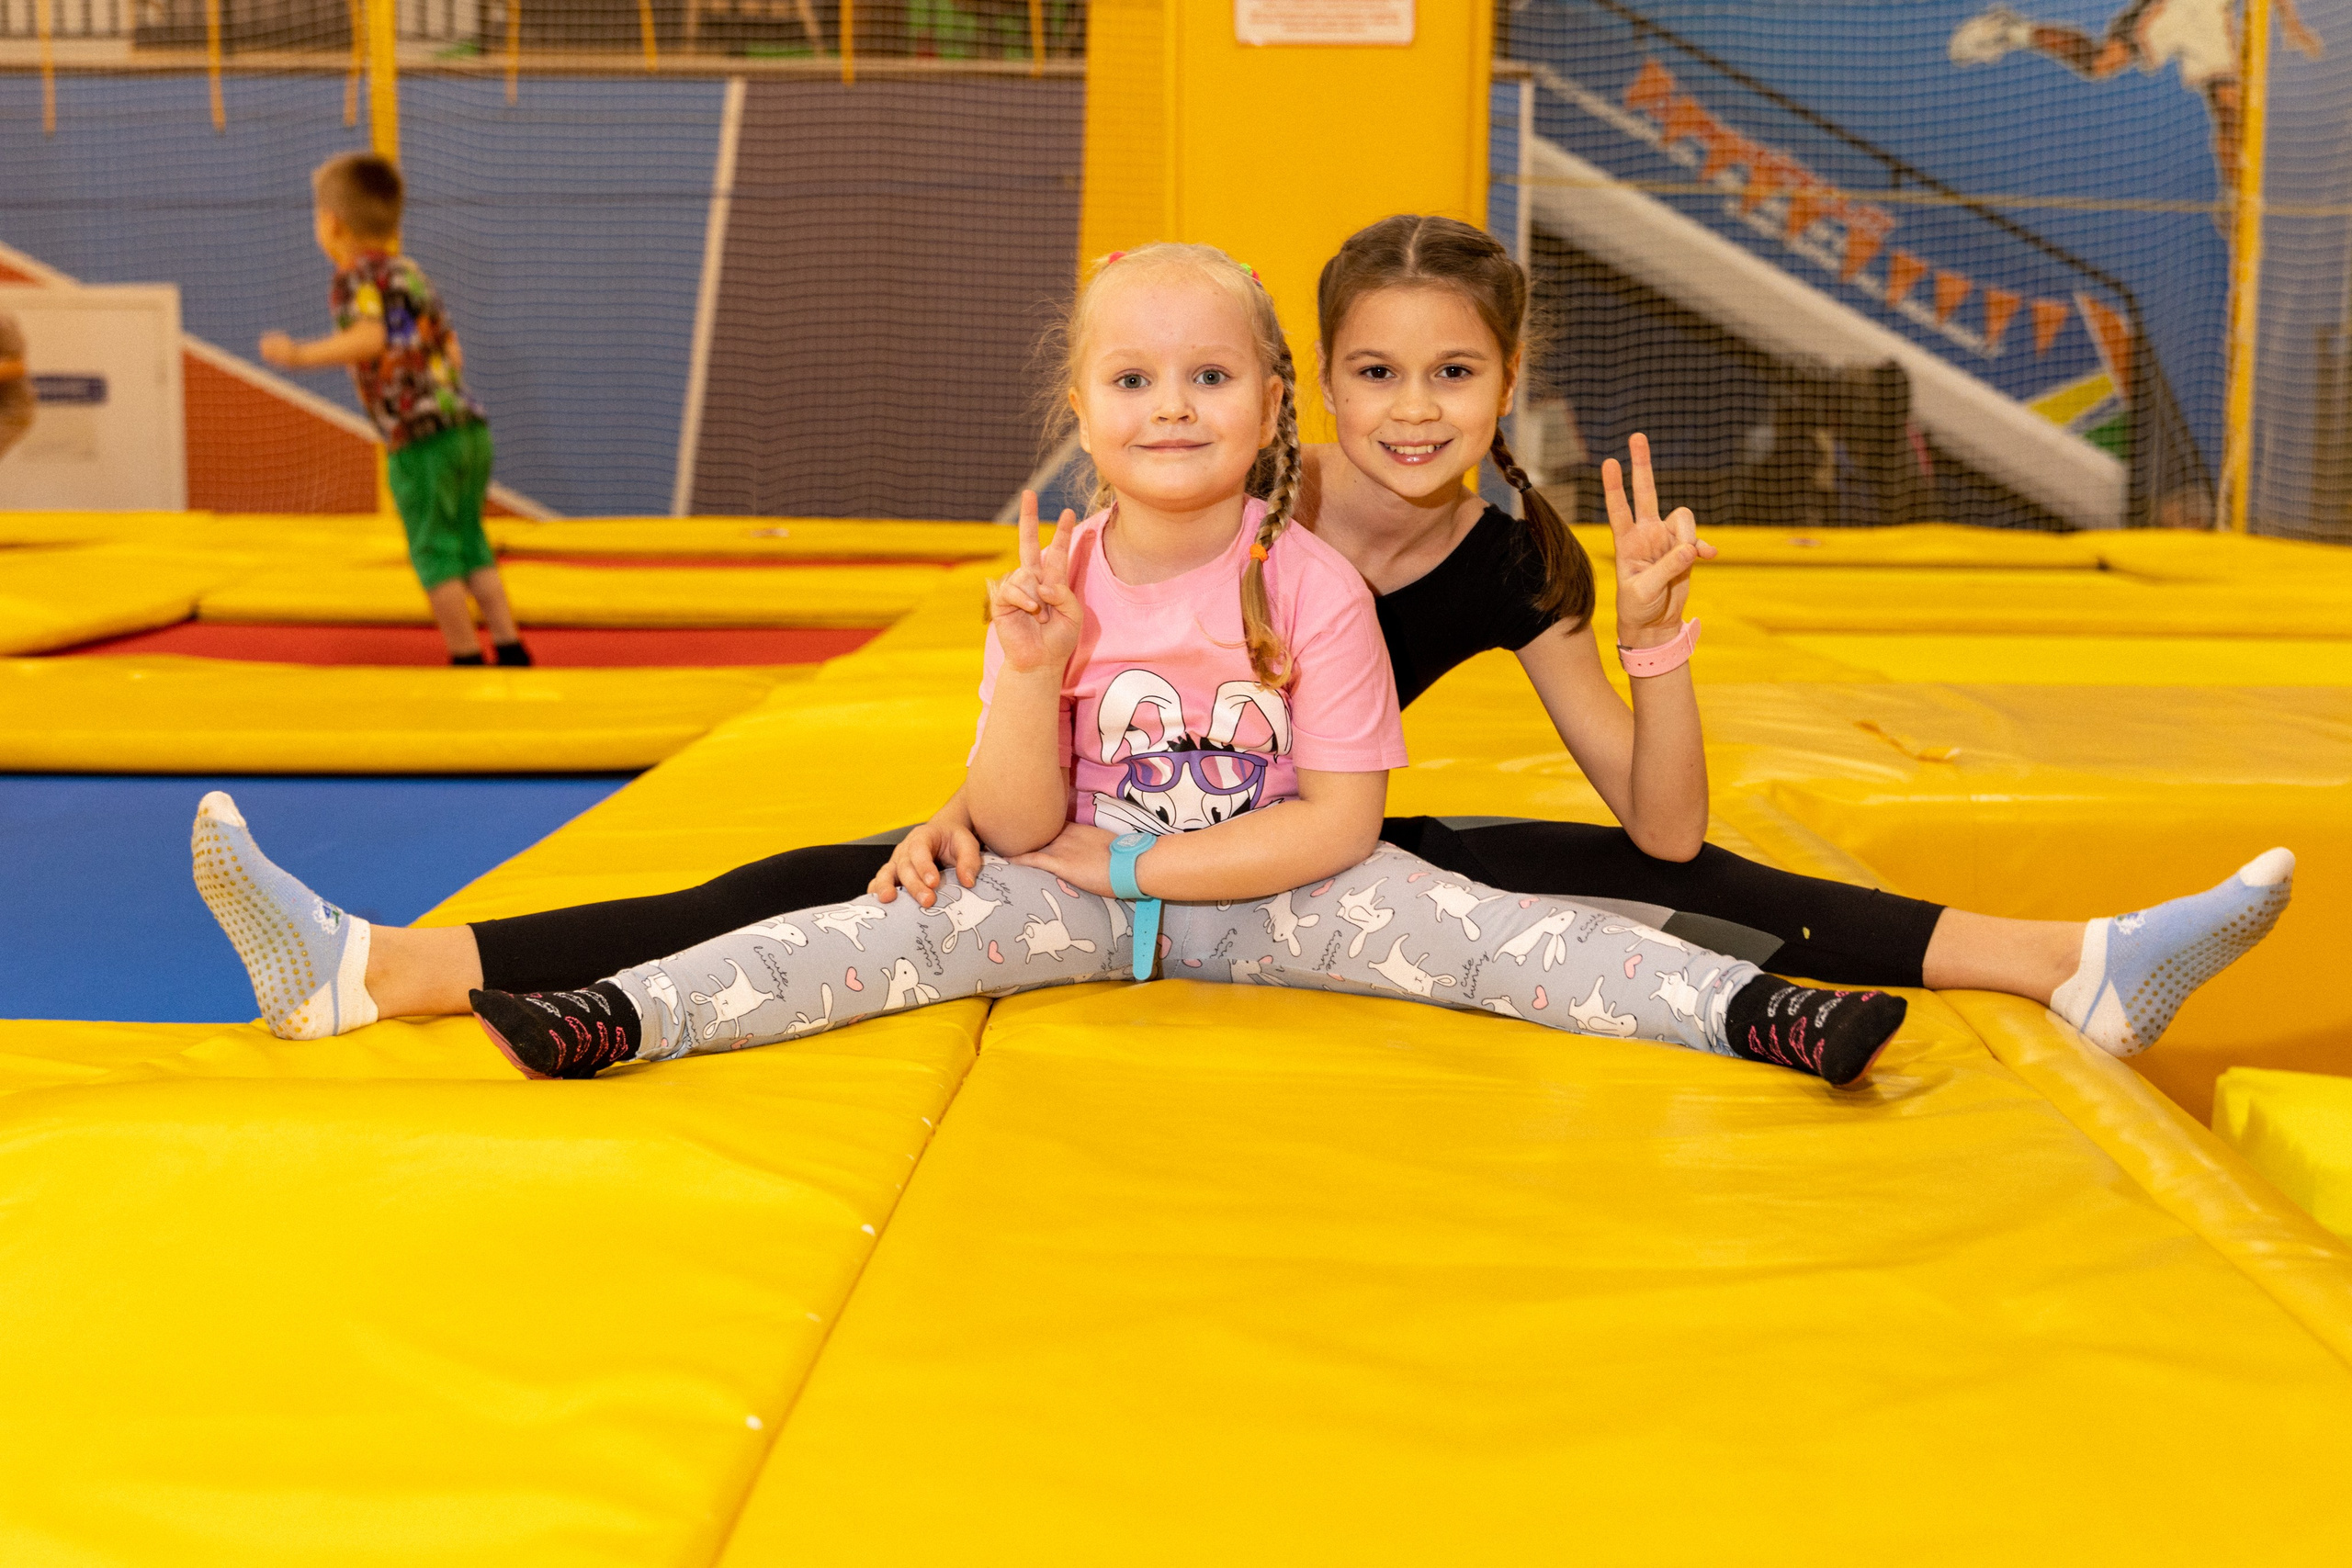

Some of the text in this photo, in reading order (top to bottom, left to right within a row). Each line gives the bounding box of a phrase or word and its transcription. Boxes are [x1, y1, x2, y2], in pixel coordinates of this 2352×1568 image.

[976, 874, 1013, 906] unny
[916, 922, 944, 976] bunny
[916, 936, 933, 967] cute
[1326, 942, 1340, 971] cute
[753, 945, 786, 1002] bunny
[768, 953, 789, 987] cute
[1461, 957, 1474, 987] cute
[1463, 951, 1489, 999] bunny
